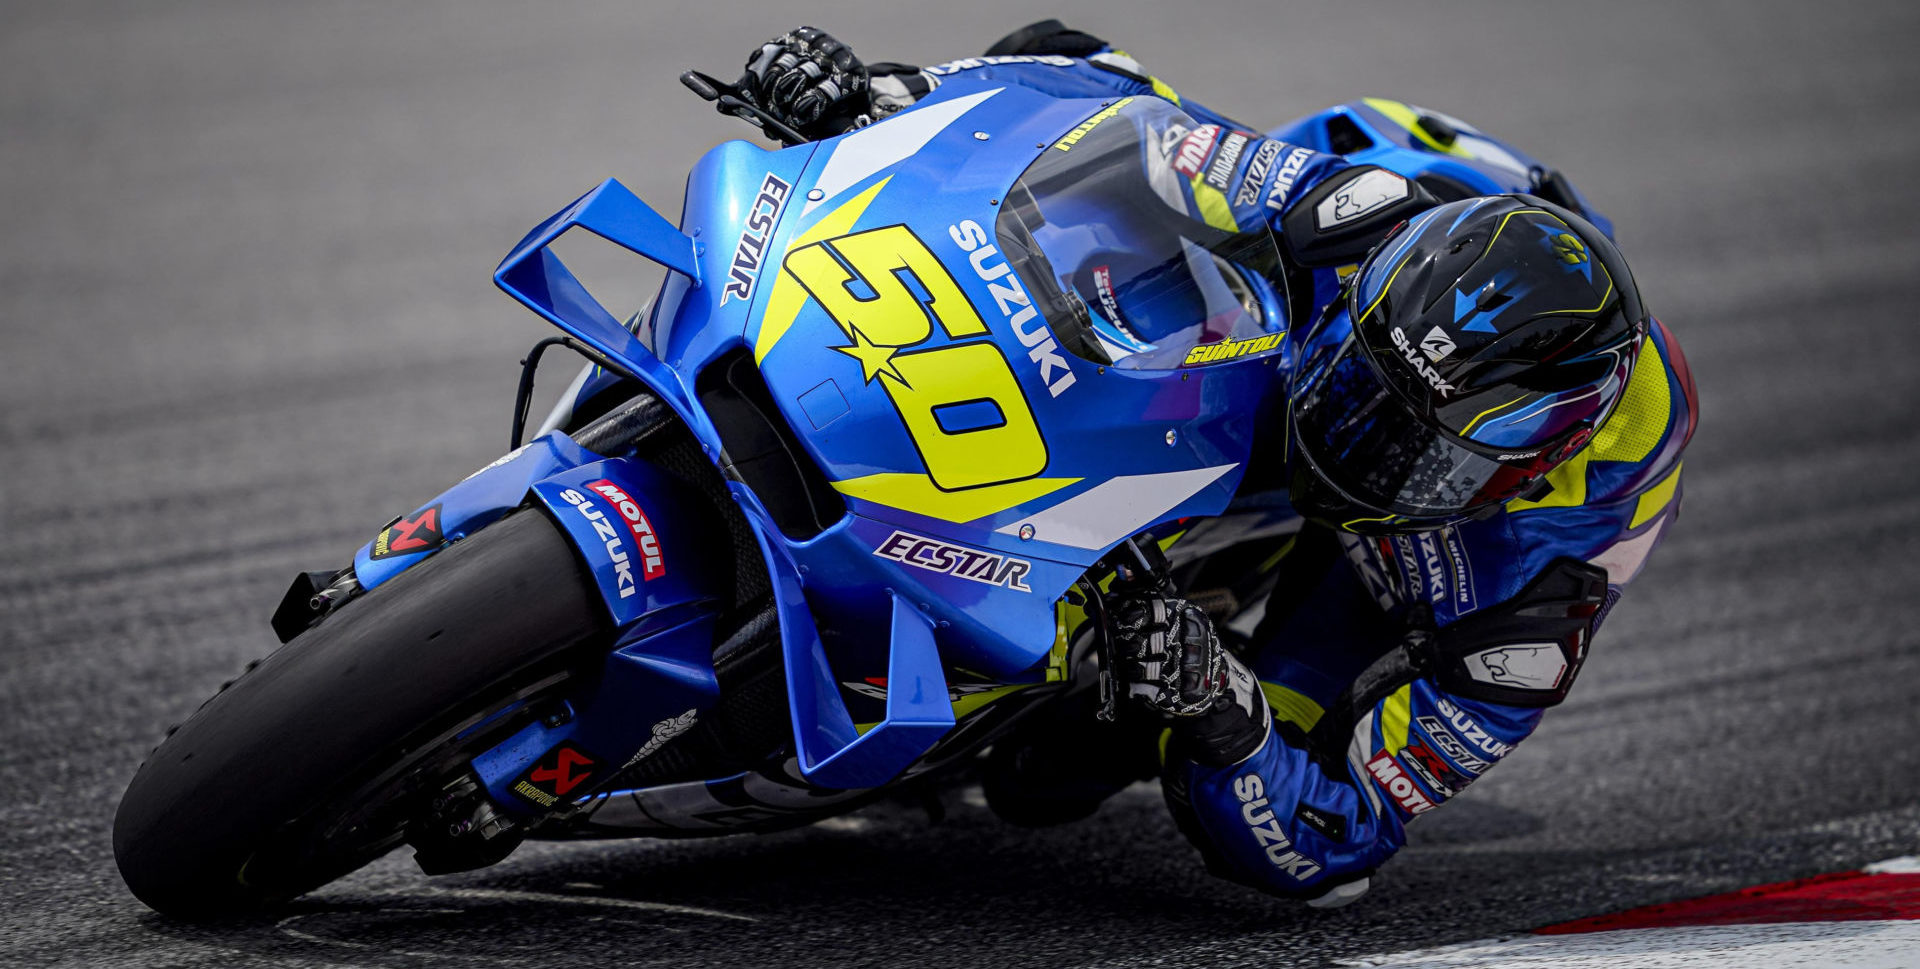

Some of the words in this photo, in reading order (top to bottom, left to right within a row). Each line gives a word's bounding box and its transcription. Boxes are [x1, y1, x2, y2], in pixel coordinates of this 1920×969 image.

[1265, 148, 1316, 211] UZUKI
[720, 171, 792, 308] ECSTAR
[948, 220, 1076, 398] SUZUKI
[783, 223, 1050, 493] 50
[1390, 326, 1456, 399] SHARK
[1497, 451, 1542, 461] SHARK
[559, 488, 636, 599] SUZUKI
[594, 485, 662, 573] MOTUL
[871, 529, 1033, 593] ECSTAR
[1448, 540, 1469, 602] MICHELIN
[1416, 716, 1491, 775] ECSTA
[1436, 698, 1513, 757] SUZUK
[1367, 756, 1438, 815] MOTU
[1233, 774, 1322, 881] SUZUKI
